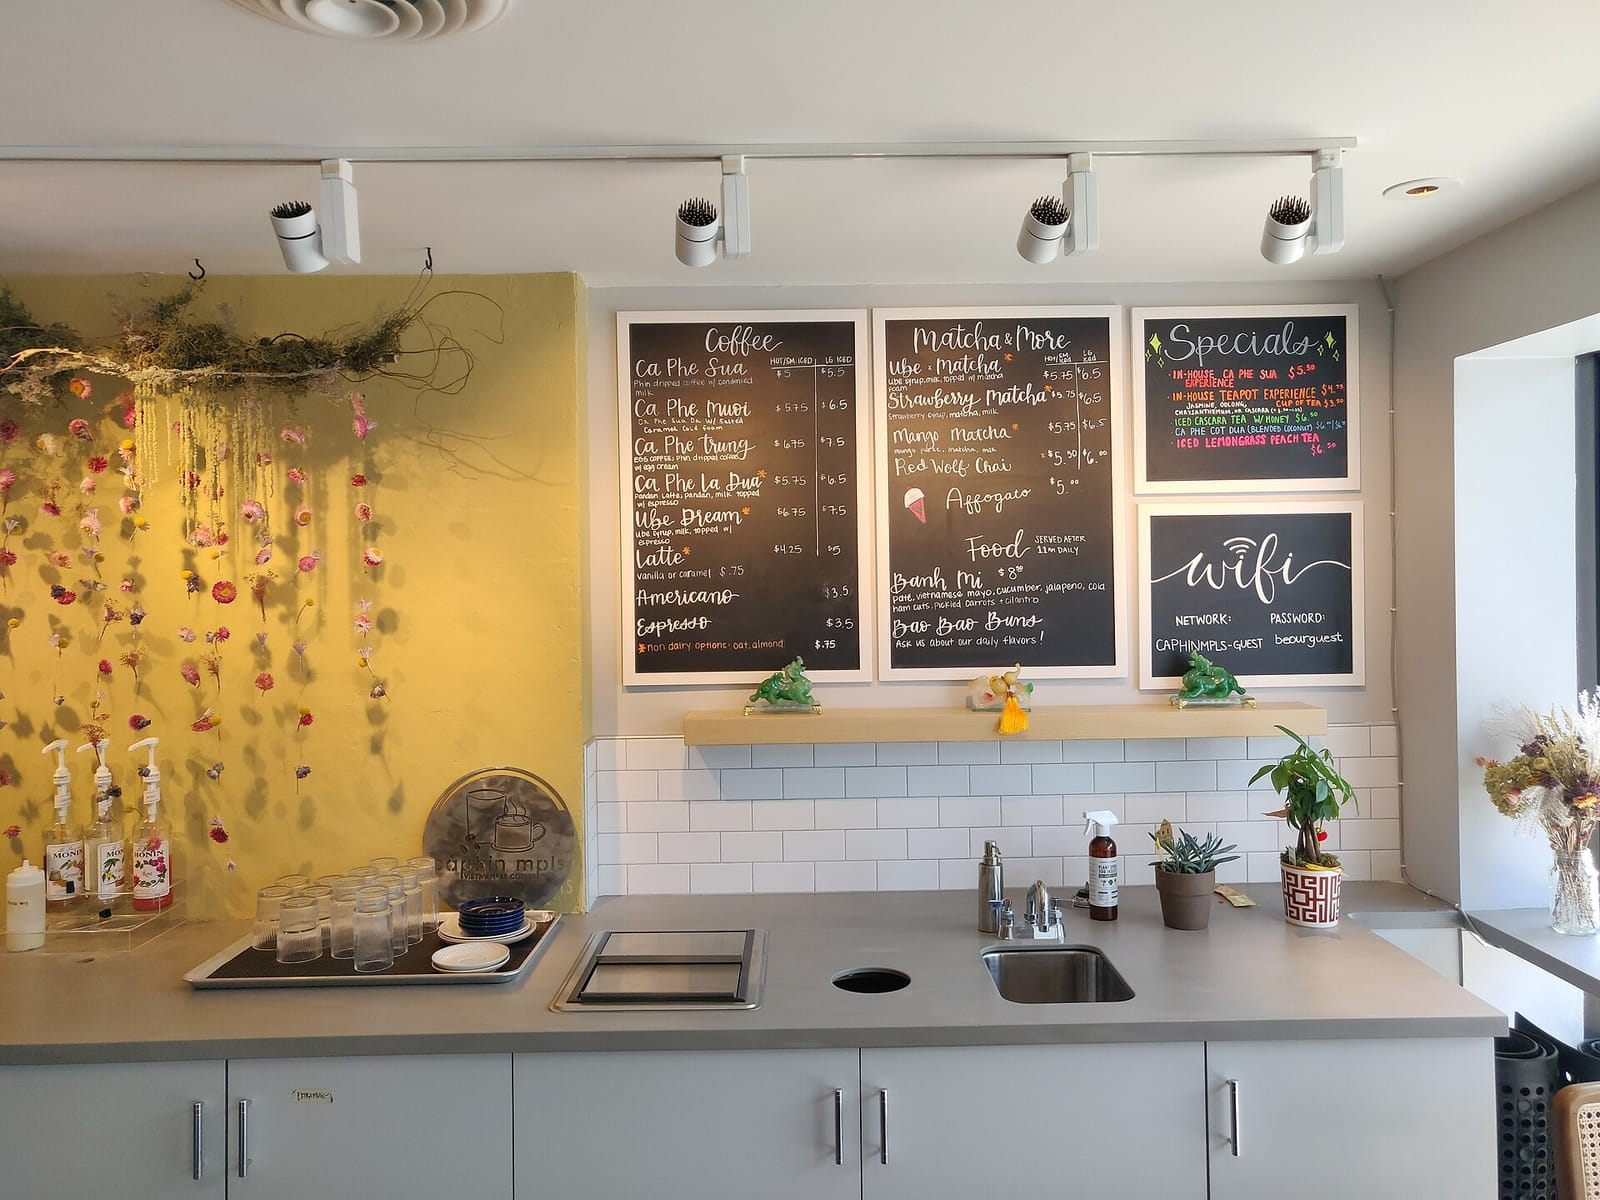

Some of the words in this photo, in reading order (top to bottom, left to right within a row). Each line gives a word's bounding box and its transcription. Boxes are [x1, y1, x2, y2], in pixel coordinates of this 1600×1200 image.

[705, 325, 783, 356] Coffee
[913, 322, 1002, 353] Matcha
[1004, 332, 1012, 345] &
[1016, 324, 1071, 351] More
[1164, 321, 1319, 367] Specials
[636, 359, 661, 378] Ca
[667, 357, 699, 377] Phe
[704, 357, 747, 378] Sua
[889, 358, 922, 378] Ube
[936, 354, 1002, 375] Matcha
[944, 374, 964, 383] topped
[1172, 370, 1214, 380] IN-HOUSE
[1223, 368, 1234, 379] CA
[1238, 368, 1254, 378] PHE
[1260, 369, 1277, 380] SUA
[653, 379, 680, 387] dripped
[1185, 378, 1234, 388] EXPERIENCE
[888, 388, 982, 414] Strawberry
[987, 383, 1047, 406] Matcha
[1172, 392, 1214, 401] IN-HOUSE
[1219, 388, 1258, 400] TEAPOT
[1264, 387, 1316, 400] EXPERIENCE
[634, 398, 658, 418] Ca
[667, 398, 698, 418] Phe
[1306, 399, 1322, 407] TEA
[1175, 417, 1192, 426] ICED
[1194, 416, 1227, 426] CASCARA
[1230, 414, 1246, 424] TEA
[892, 428, 939, 449] Mango
[951, 426, 1012, 442] Matcha
[1175, 428, 1186, 436] CA
[1190, 427, 1206, 436] PHE
[1210, 426, 1226, 435] COT
[1229, 426, 1246, 434] DUA
[634, 438, 658, 456] Ca
[664, 436, 694, 454] Phe
[1177, 438, 1199, 448] ICED
[1205, 434, 1266, 448] LEMONGRASS
[1270, 434, 1298, 445] PEACH
[1301, 432, 1320, 443] TEA
[643, 464, 656, 472] egg
[895, 458, 928, 476] Red
[930, 458, 970, 478] Wolf
[976, 456, 1012, 474] Chai
[634, 474, 660, 493] Ca
[666, 472, 696, 492] Phe
[701, 472, 720, 492] La
[726, 472, 762, 492] Dua
[736, 489, 760, 498] topped
[946, 487, 1032, 514] Affogato
[648, 500, 679, 508] espresso
[636, 508, 674, 530] Ube
[680, 508, 742, 527] Dream
[694, 526, 718, 536] topped
[638, 538, 670, 547] espresso
[965, 528, 1031, 562] Food
[1034, 536, 1062, 544] SERVED
[636, 546, 686, 569] Latte
[1058, 546, 1079, 556] DAILY
[679, 569, 712, 579] caramel
[891, 566, 947, 594] Banh
[957, 570, 983, 590] Mi
[1088, 582, 1106, 591] cold
[636, 589, 740, 606] Americano
[892, 604, 910, 612] ham
[892, 620, 931, 638] Bao
[936, 616, 978, 636] Bao
[985, 612, 1043, 630] Buns
[1176, 614, 1232, 626] NETWORK:
[1270, 612, 1325, 624] PASSWORD:
[636, 616, 712, 637] Espresso
[648, 644, 666, 652] non
[668, 642, 691, 652] dairy
[752, 640, 784, 650] almond
[815, 640, 836, 650] $.75
[896, 639, 912, 648] Ask
[916, 638, 926, 647] us
[930, 638, 954, 647] about
[976, 636, 998, 648] daily
[1156, 638, 1263, 652] CAPHINMPLS-GUEST
[1275, 632, 1344, 648] beourguest
